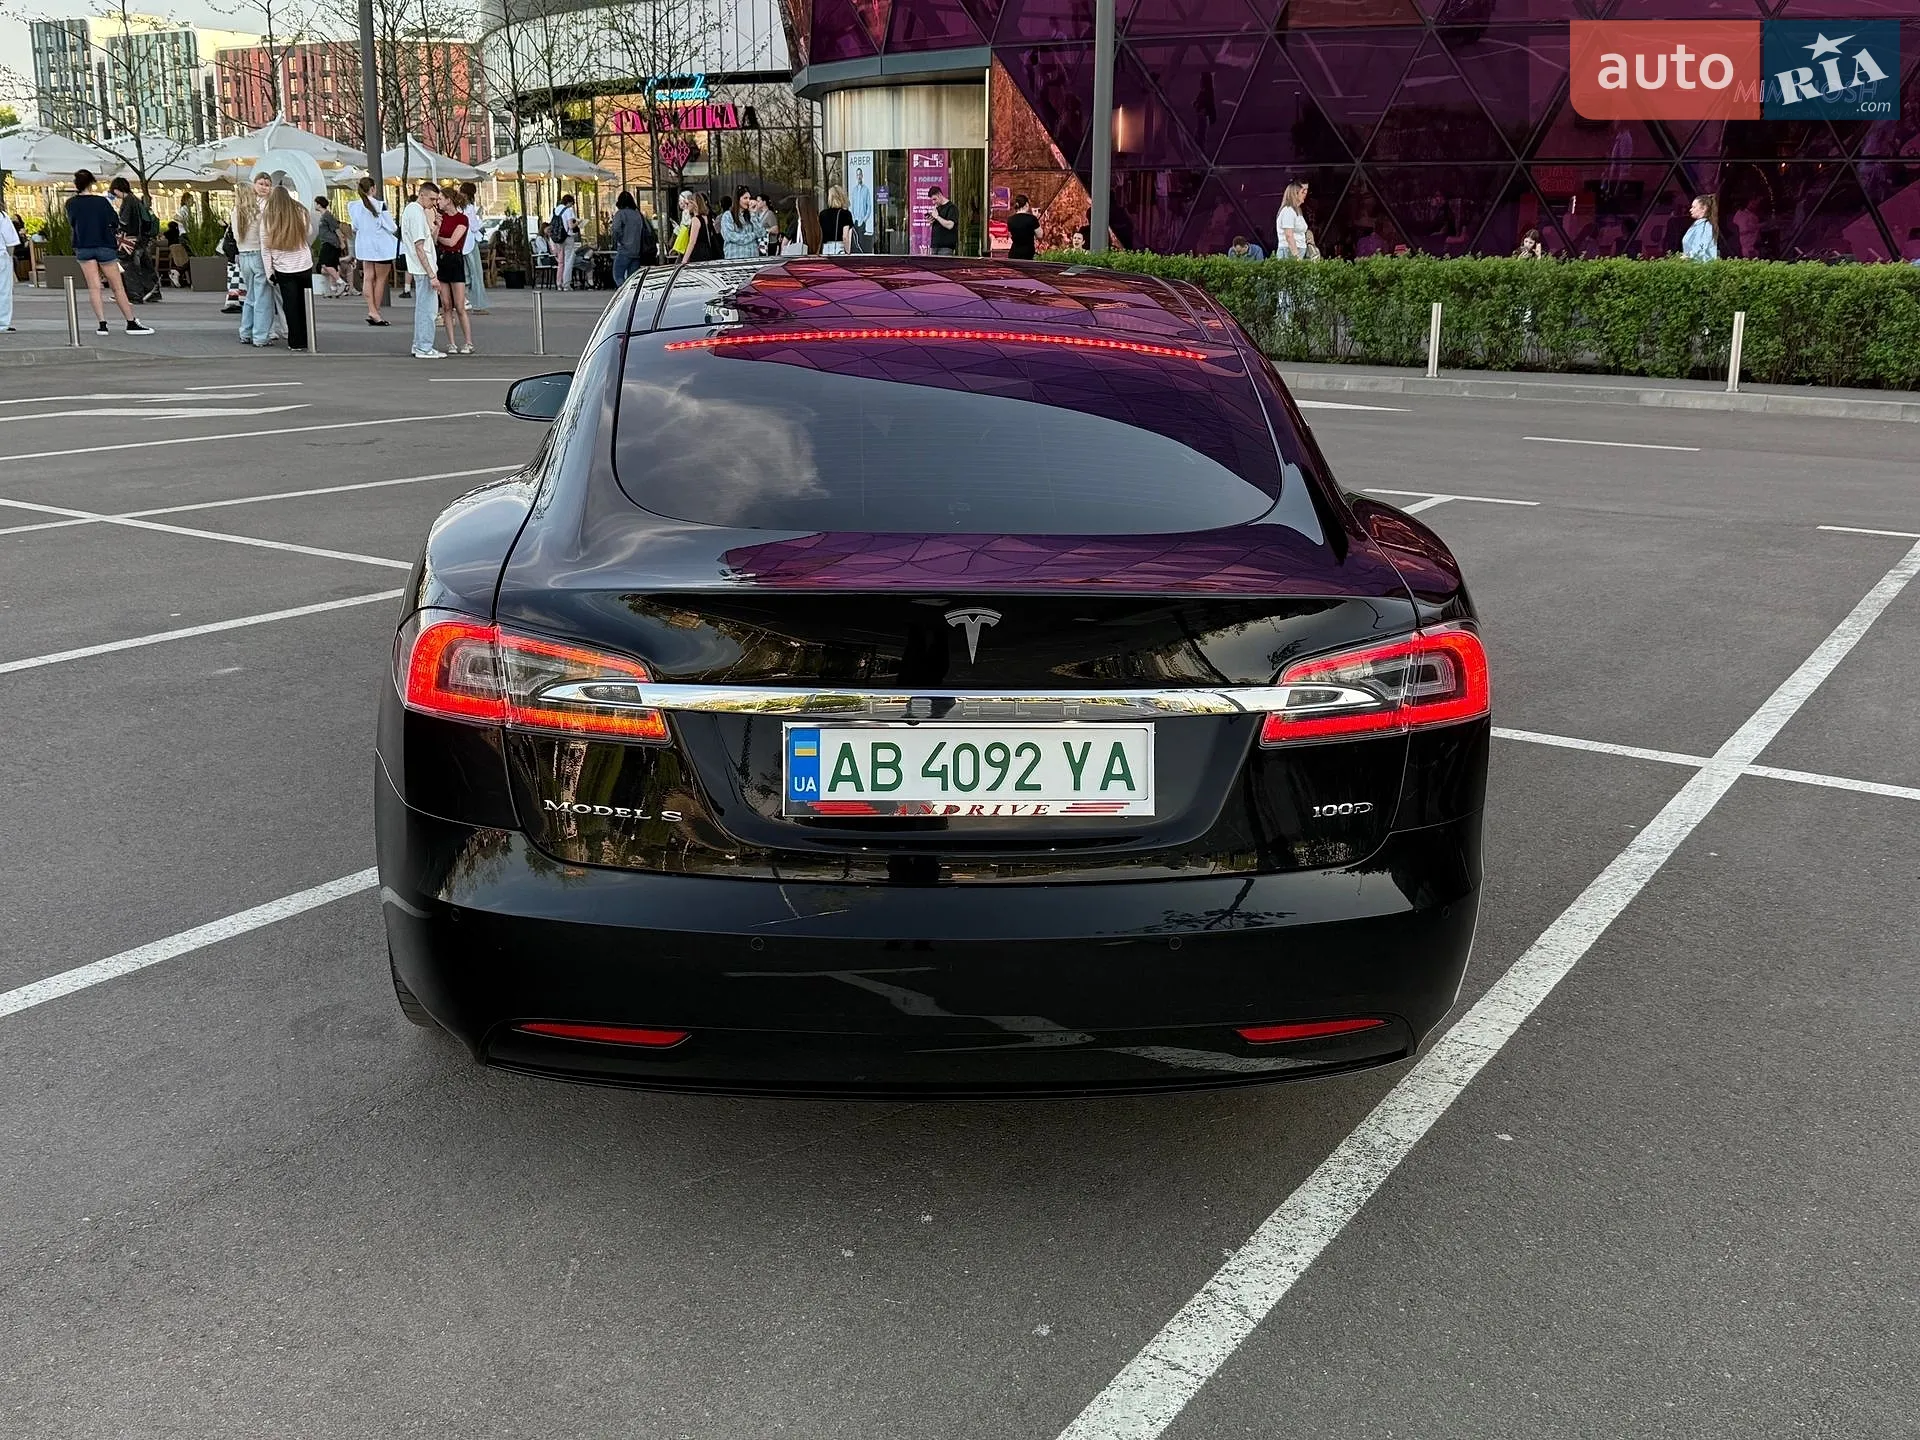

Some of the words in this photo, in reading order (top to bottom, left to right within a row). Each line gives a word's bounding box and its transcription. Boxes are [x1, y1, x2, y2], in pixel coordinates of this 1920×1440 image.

[849, 156, 871, 166] ARBER
[827, 741, 903, 793] AB
[920, 741, 1042, 793] 4092
[1062, 741, 1136, 793] YA
[794, 776, 817, 793] UA
[543, 799, 652, 820] MODEL
[661, 810, 683, 823] S
